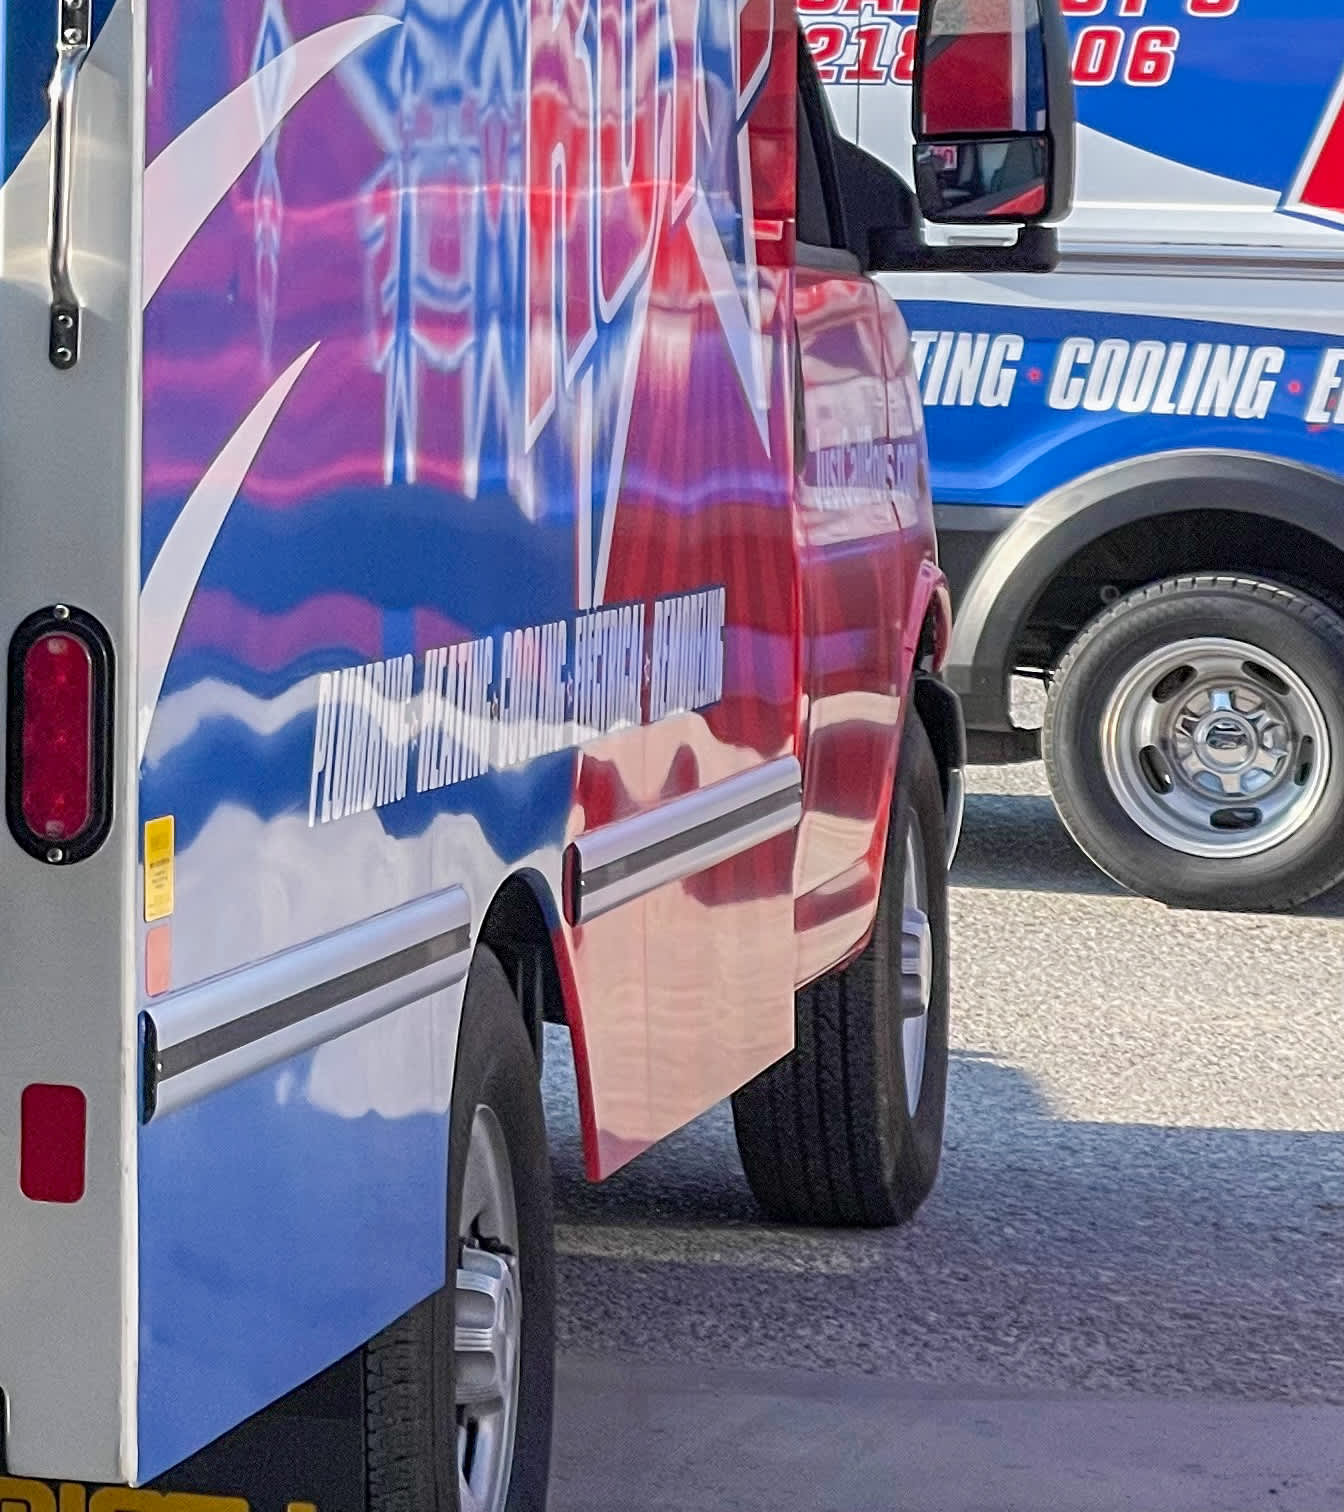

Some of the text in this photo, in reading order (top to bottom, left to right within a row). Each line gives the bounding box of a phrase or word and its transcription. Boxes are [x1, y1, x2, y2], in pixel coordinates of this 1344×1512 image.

[1047, 336, 1286, 421] COOLING
[308, 587, 726, 828] PLUMBING HEATING COOLING ELECTRICAL REMODELING
